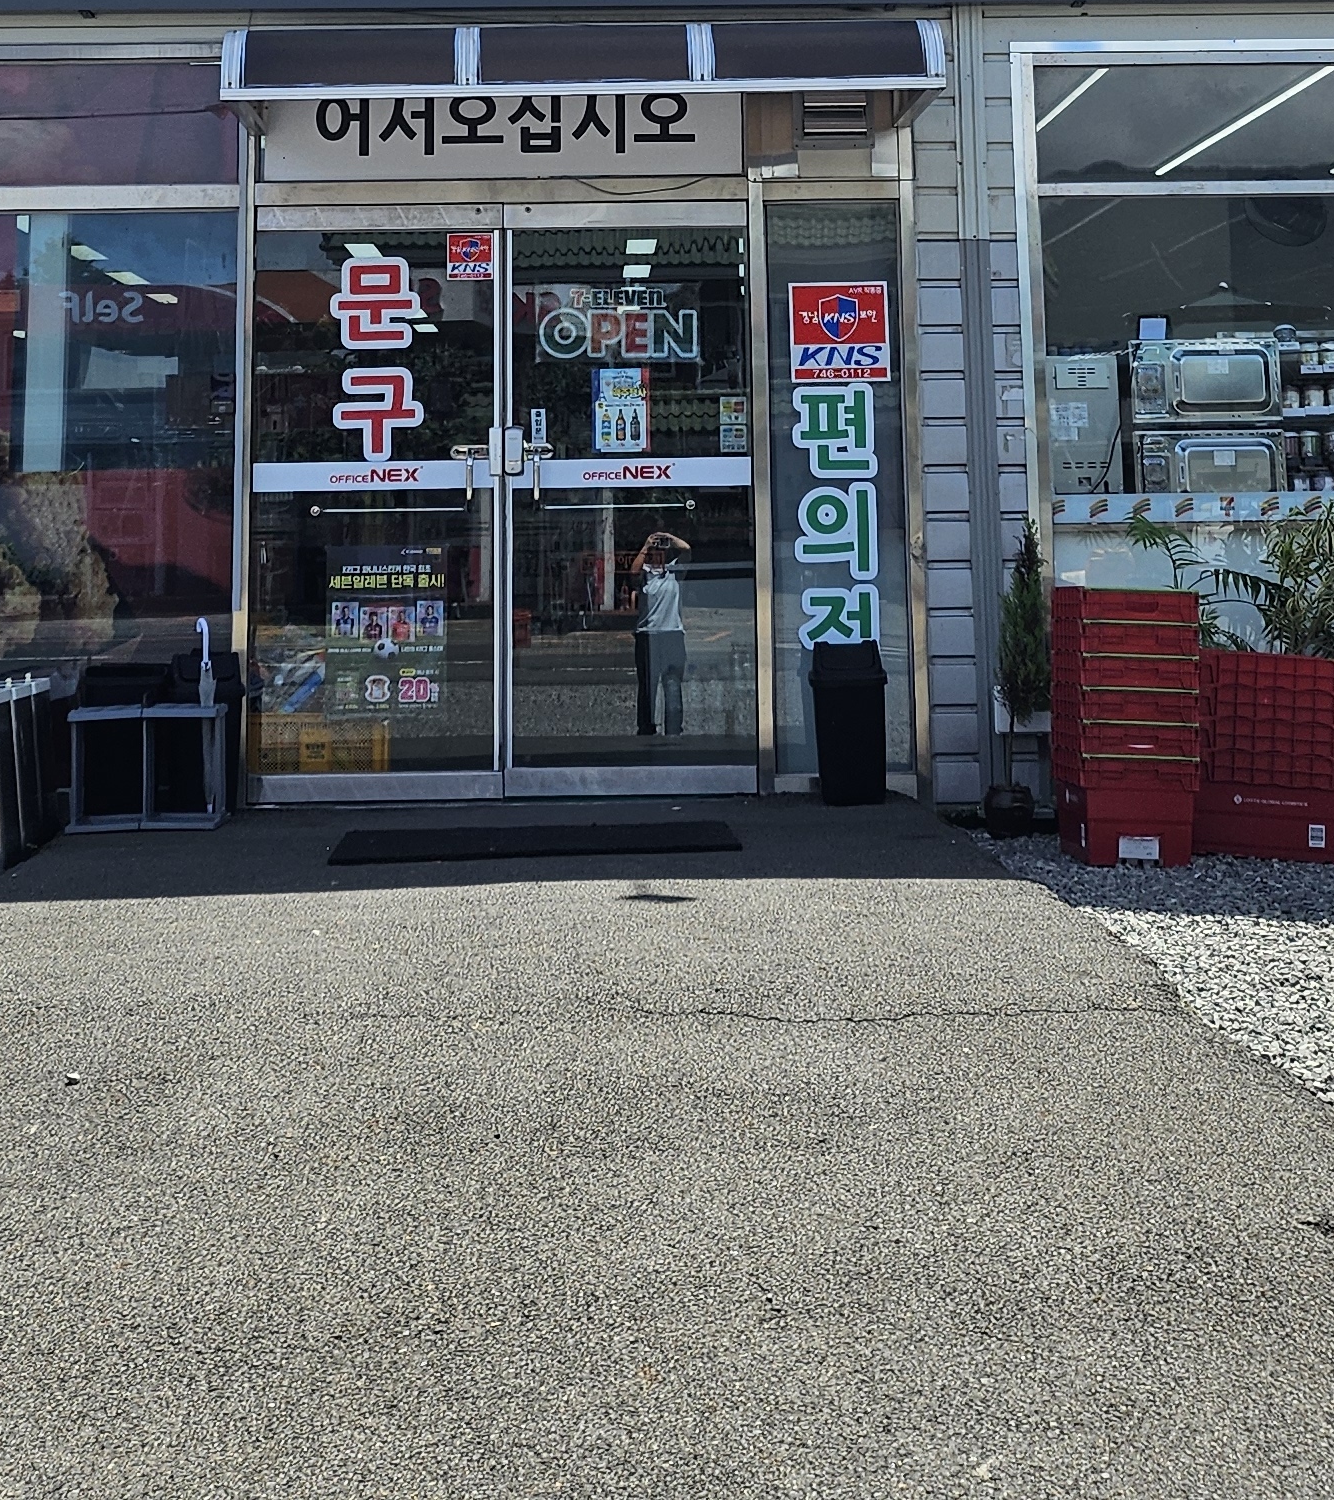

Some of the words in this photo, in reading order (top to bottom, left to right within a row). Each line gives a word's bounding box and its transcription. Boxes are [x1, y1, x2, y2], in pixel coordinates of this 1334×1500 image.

[315, 94, 696, 157] 어서오십시오
[451, 263, 490, 273] KNS
[824, 311, 855, 324] KNS
[539, 308, 698, 358] OPEN
[797, 344, 883, 367] KNS
[812, 368, 871, 378] 746-0112
[328, 574, 388, 589] 세븐일레븐
[391, 573, 414, 588] 단독
[417, 573, 445, 588] 출시!
